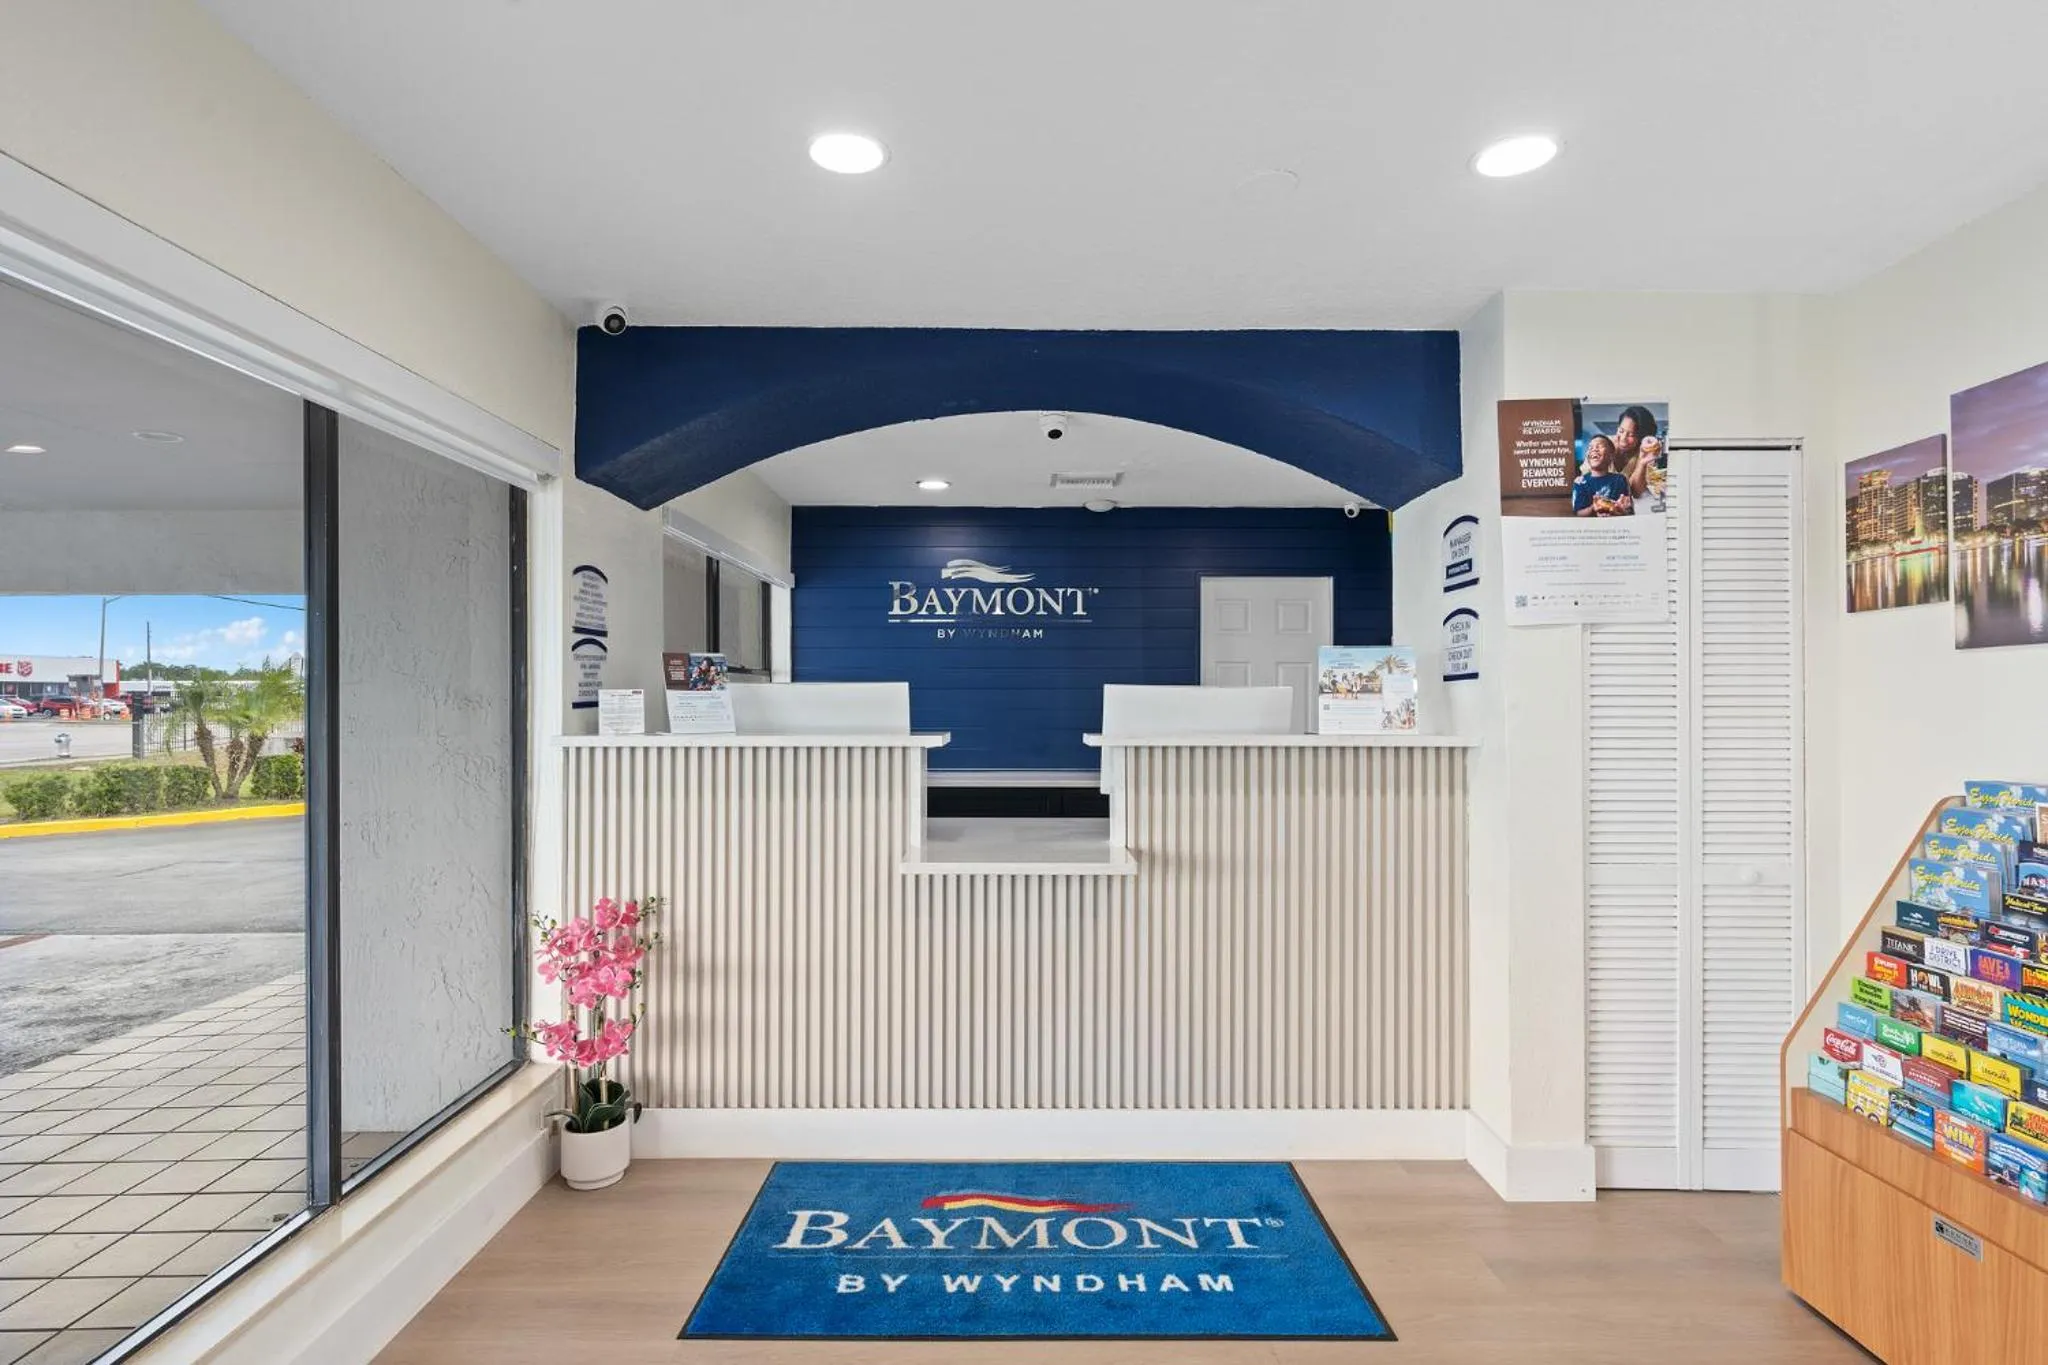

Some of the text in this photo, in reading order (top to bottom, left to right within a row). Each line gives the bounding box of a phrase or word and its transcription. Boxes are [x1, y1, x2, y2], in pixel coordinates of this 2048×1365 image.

[1522, 426, 1562, 435] REWARDS
[1519, 457, 1566, 468] WYNDHAM
[1522, 467, 1565, 478] REWARDS
[1521, 477, 1569, 489] EVERYONE.
[888, 581, 1090, 616] BAYMONT
[937, 628, 1043, 639] BY WYNDHAM
[1886, 938, 1918, 952] TITANIC
[1943, 1122, 1975, 1150] WIN
[772, 1209, 1262, 1250] BAYMONT
[837, 1273, 1235, 1294] BY WYNDHAM
